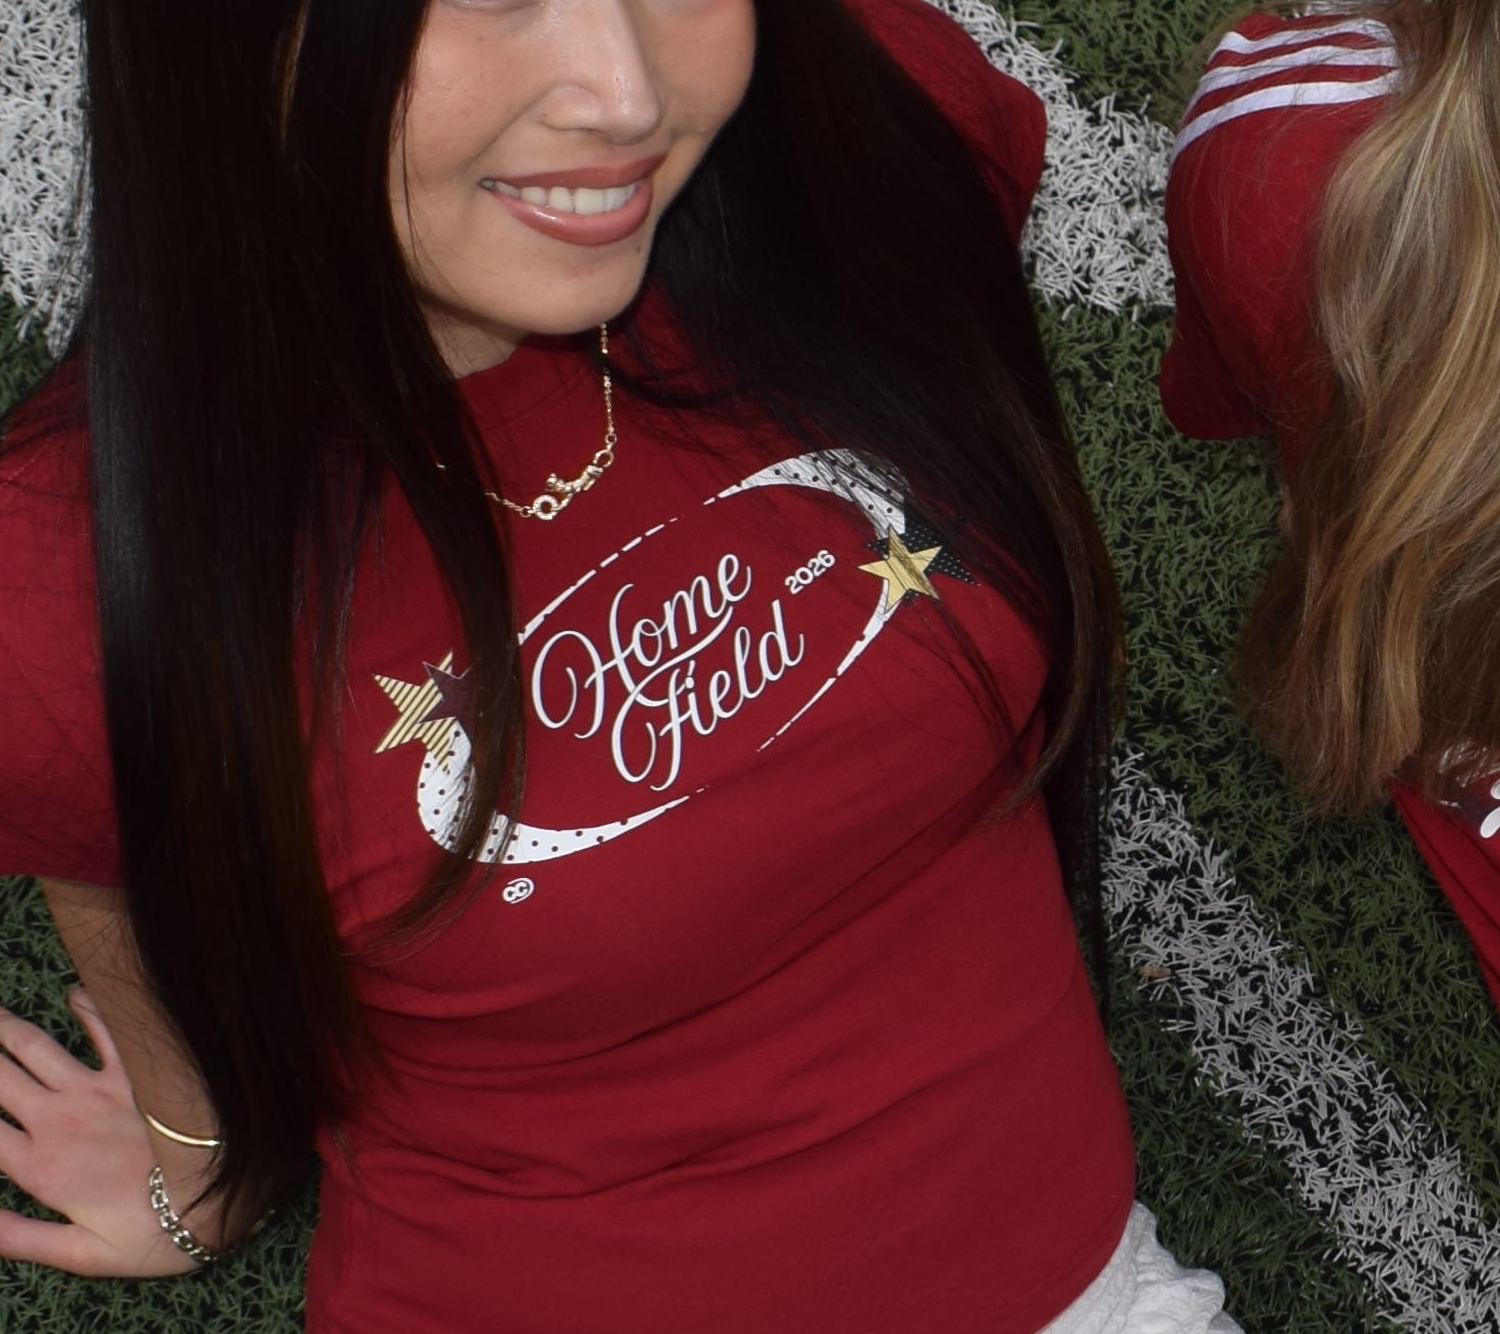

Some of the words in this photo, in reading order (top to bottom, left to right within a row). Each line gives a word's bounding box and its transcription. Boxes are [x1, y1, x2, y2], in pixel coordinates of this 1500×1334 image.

[531, 553, 752, 739] Home
[784, 549, 836, 595] 2026
[610, 599, 804, 792] Field
